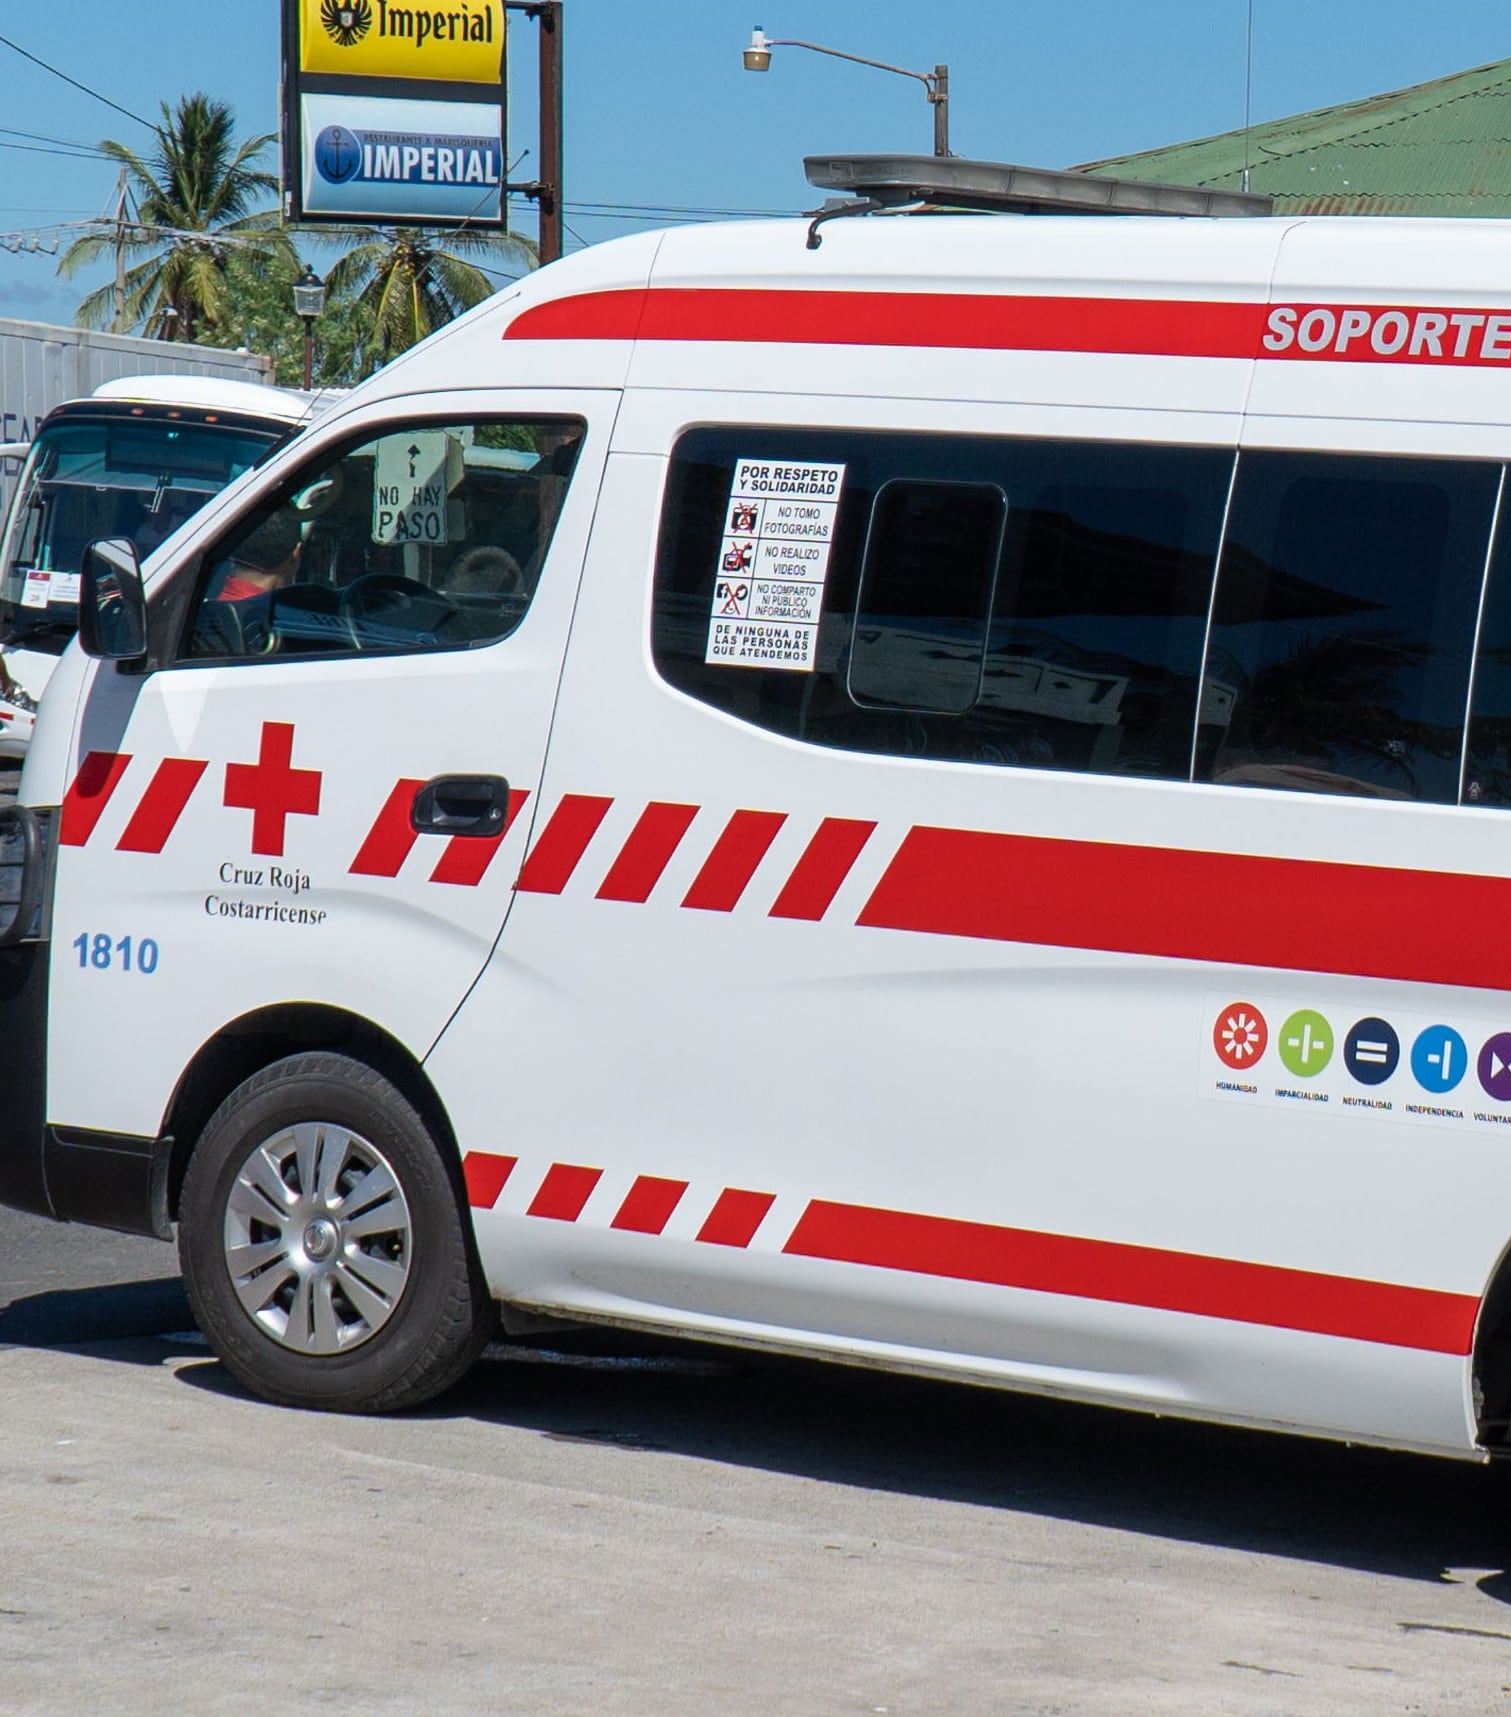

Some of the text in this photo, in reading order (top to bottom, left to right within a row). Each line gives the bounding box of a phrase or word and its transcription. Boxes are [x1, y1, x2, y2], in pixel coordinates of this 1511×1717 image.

[377, 0, 492, 48] Imperial
[364, 133, 421, 145] RESTAURANTE
[363, 144, 499, 184] IMPERIAL
[740, 465, 838, 483] POR RESPETO
[740, 479, 835, 495] Y SOLIDARIDAD
[379, 486, 442, 507] NO HAY
[778, 506, 820, 520] NO TOMO
[378, 510, 440, 540] PASO
[764, 520, 828, 537] FOTOGRAFÍAS
[765, 546, 819, 560] NO REALIZO
[773, 563, 806, 576] VIDEOS
[757, 584, 816, 597] NO COMPARTO
[762, 595, 807, 608] NI PUBLICO
[716, 624, 810, 640] DE NINGUNA DE
[714, 635, 808, 651] LAS PERSONAS
[713, 645, 808, 661] QUE ATENDEMOS
[219, 862, 311, 895] Cruz Roja
[204, 894, 327, 925] Costarricense
[72, 932, 158, 974] 1810
[1216, 1081, 1258, 1093] HUMANIDAD
[1275, 1088, 1329, 1102] IMPARCIALIDAD
[1343, 1096, 1392, 1110] NEUTRALIDAD
[1405, 1103, 1464, 1119] INDEPENDENCIA
